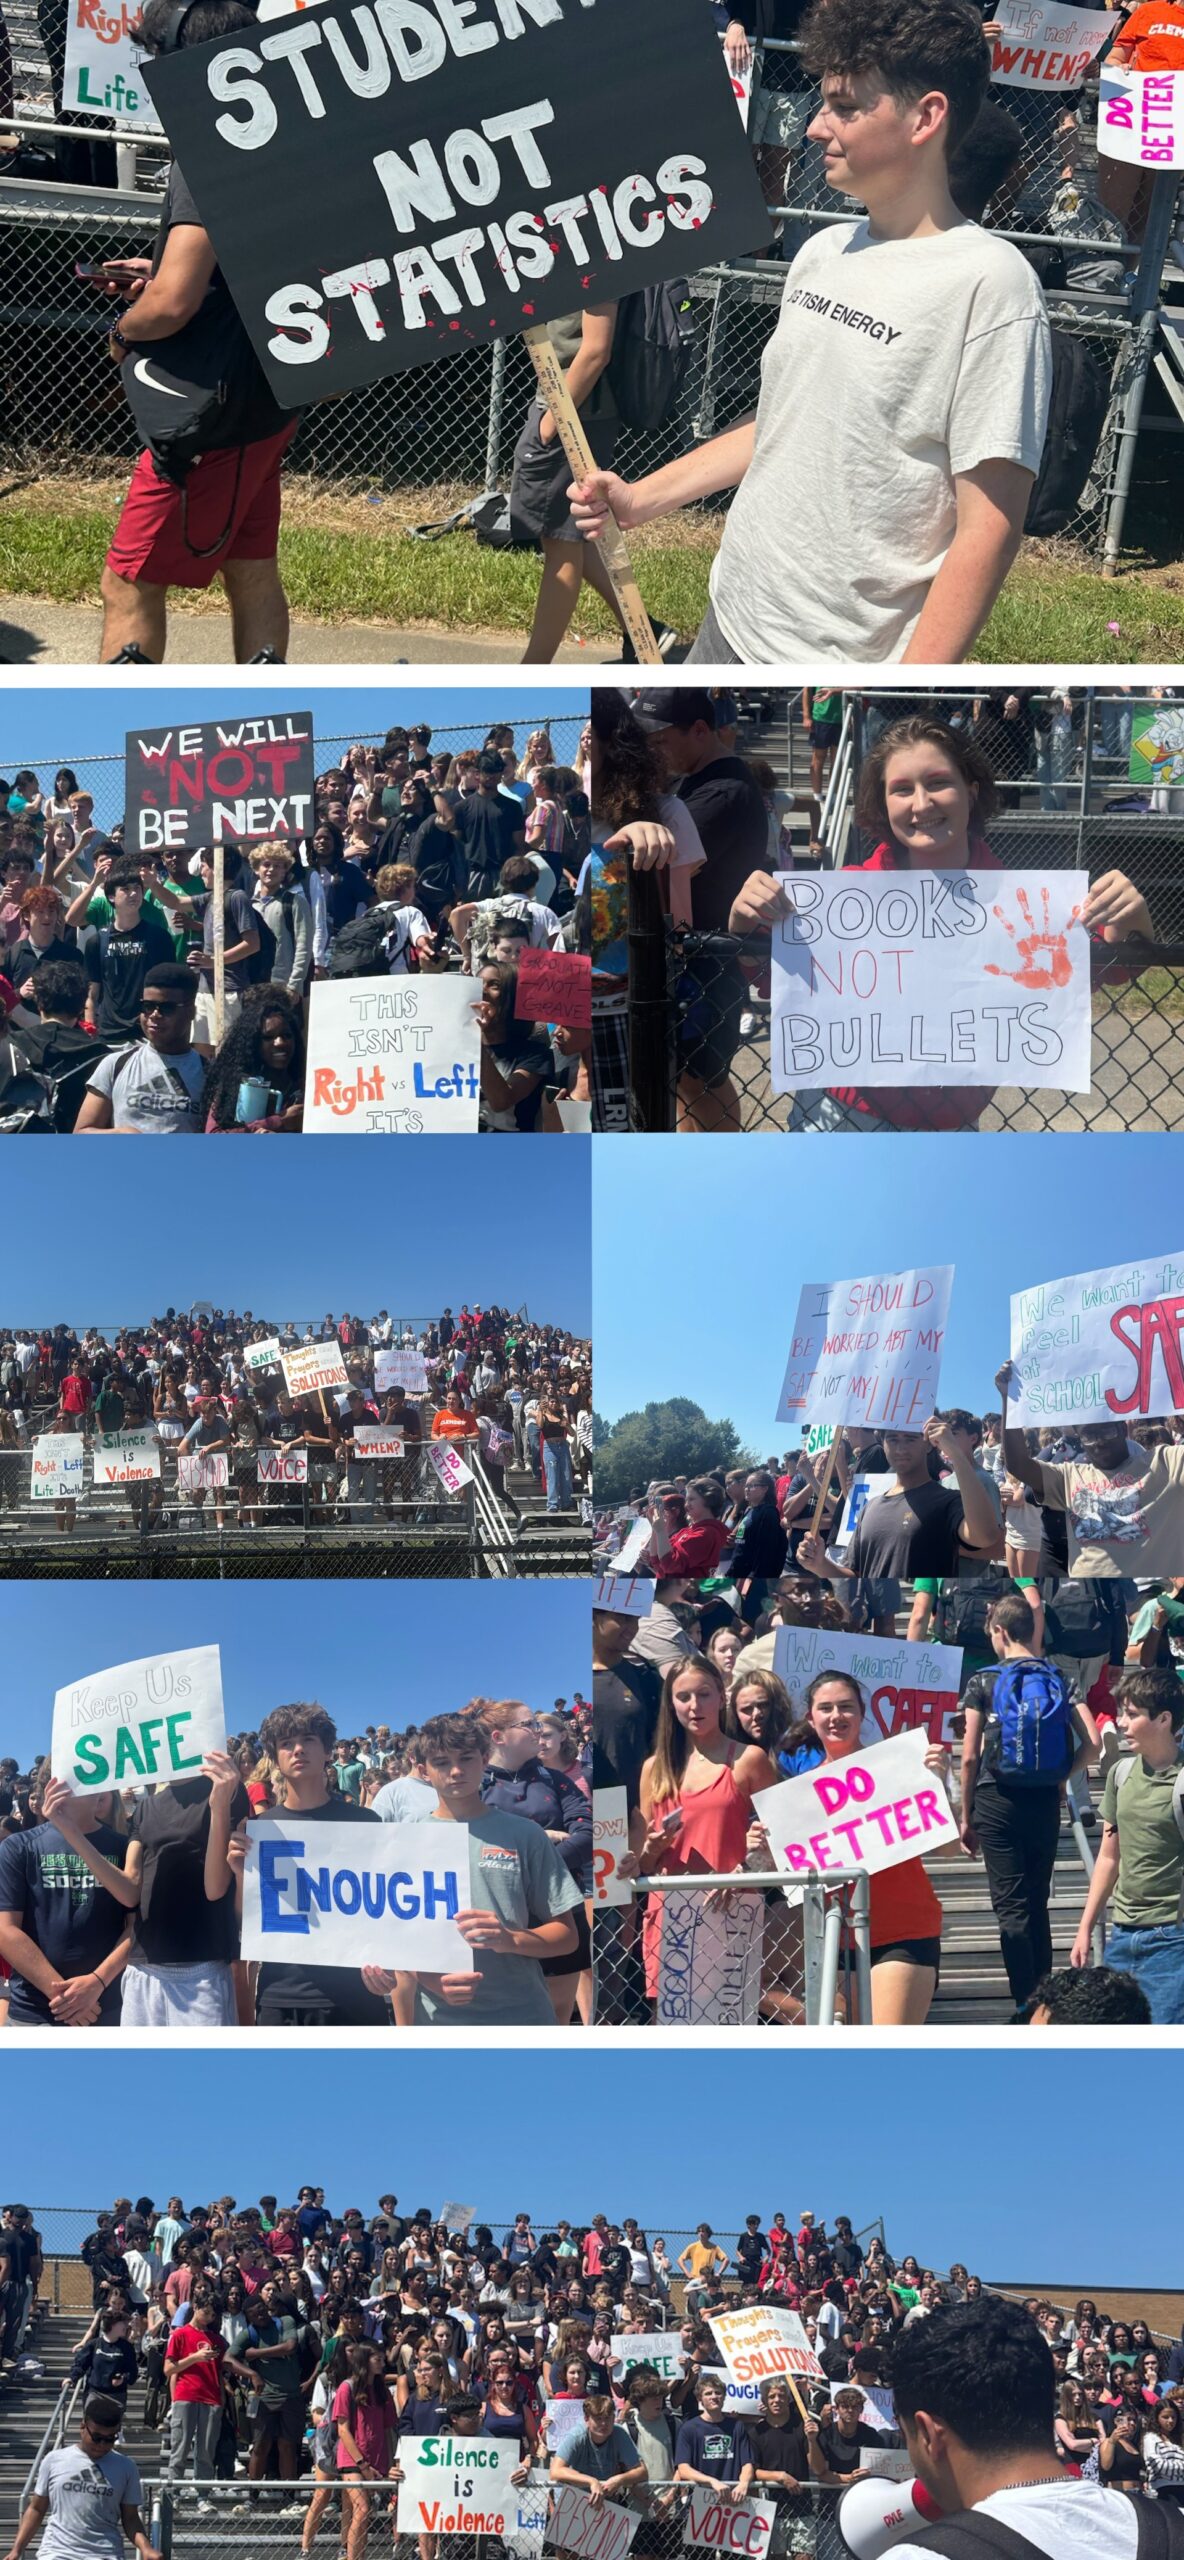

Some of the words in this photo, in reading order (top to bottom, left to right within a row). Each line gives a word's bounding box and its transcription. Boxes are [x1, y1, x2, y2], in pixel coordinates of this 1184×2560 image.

[1001, 2, 1043, 39] If
[1044, 21, 1077, 44] not
[207, 0, 596, 150] STUDE
[992, 41, 1091, 85] WHEN?
[77, 67, 139, 112] Life
[1106, 97, 1134, 129] DO
[1141, 74, 1175, 162] BETTER
[373, 99, 555, 233] NOT
[265, 154, 714, 364] STATISTICS
[830, 303, 902, 345] ENERGY
[138, 728, 203, 758] WE
[216, 718, 308, 747] WILL
[169, 745, 300, 806] NOT
[139, 808, 189, 850] BE
[212, 795, 311, 841] NEXT
[782, 877, 987, 945] BOOKS
[811, 950, 914, 998] NOT
[350, 990, 418, 1020] THIS
[348, 1025, 433, 1057] ISN'T
[781, 1002, 1063, 1075] BULLETS
[127, 1092, 200, 1114] adidas
[313, 1065, 386, 1116] Right
[391, 1080, 406, 1090] vs
[413, 1062, 479, 1099] Left
[366, 1107, 424, 1133] IT'S
[811, 1289, 834, 1318] I
[845, 1280, 934, 1317] SHOULD
[1020, 1286, 1065, 1329] We
[1082, 1270, 1145, 1311] want
[250, 1349, 277, 1366] SAFE
[791, 1336, 816, 1358] BE
[822, 1331, 879, 1355] WORRIED
[883, 1329, 913, 1353] ABT
[915, 1329, 944, 1353] MY
[289, 1365, 349, 1395] SOLUTIONS
[1021, 1357, 1041, 1381] at
[787, 1371, 818, 1399] SAT
[820, 1374, 846, 1399] NOT
[846, 1376, 873, 1400] MY
[865, 1375, 931, 1425] LIFE
[1026, 1373, 1107, 1415] SCHOOL
[102, 1433, 146, 1449] Silence
[123, 1451, 135, 1463] is
[358, 1441, 401, 1455] WHEN?
[808, 1424, 834, 1453] SAFE
[34, 1461, 57, 1475] Right
[105, 1466, 154, 1482] Violence
[430, 1446, 460, 1490] BETTER
[446, 1452, 461, 1469] DO
[34, 1484, 54, 1497] Life
[786, 1632, 836, 1673] We
[851, 1650, 908, 1680] want
[916, 1652, 943, 1684] to
[71, 1686, 138, 1728] Keep
[145, 1665, 192, 1704] Us
[73, 1711, 203, 1786] SAFE
[813, 1766, 875, 1816] DO
[784, 1790, 949, 1871] BETTER
[42, 1875, 103, 1888] SOCC
[259, 1840, 458, 1934] ENOUGH
[662, 1903, 690, 2018] BOOKS
[714, 2308, 774, 2333] Thoughts
[722, 2328, 782, 2353] Prayers
[626, 2356, 676, 2376] SFE
[733, 2346, 824, 2382] SOLUTIONS
[417, 2438, 499, 2469] Silence
[62, 2481, 114, 2496] adidas
[454, 2473, 474, 2497] is
[418, 2502, 504, 2534] Violence
[547, 2487, 630, 2560] RESPOND
